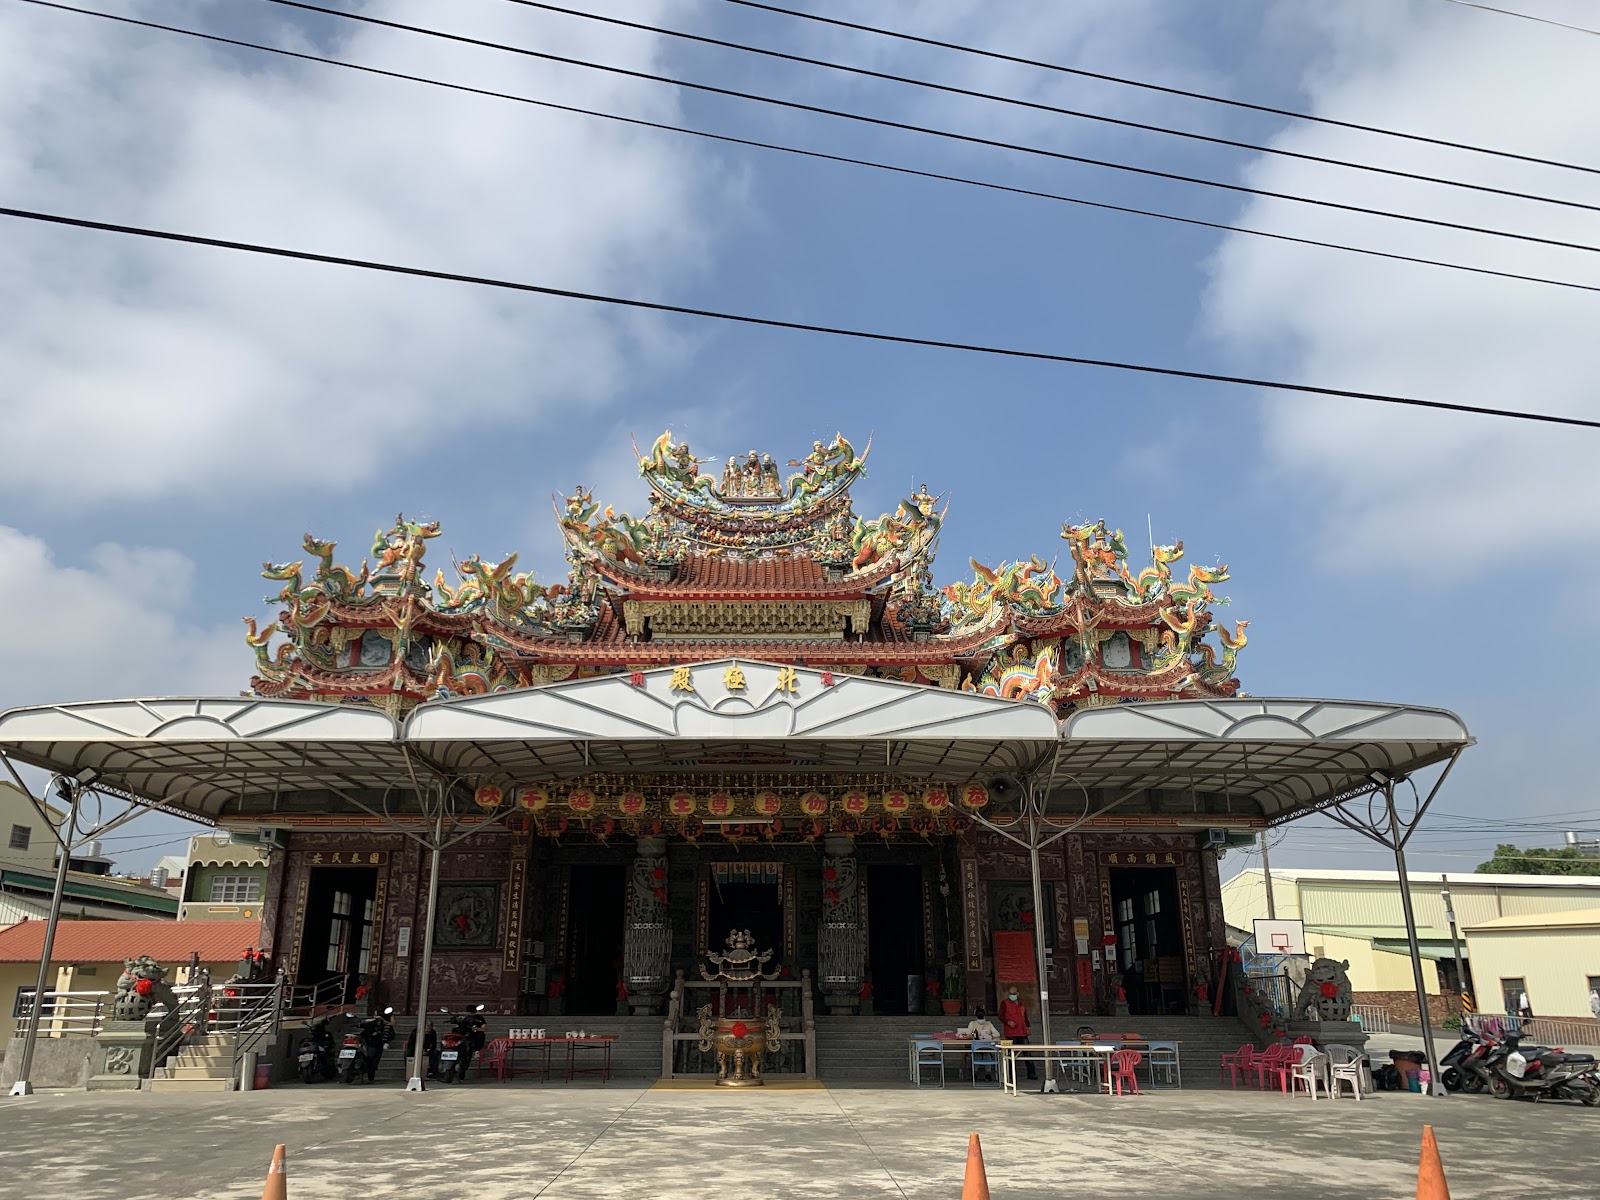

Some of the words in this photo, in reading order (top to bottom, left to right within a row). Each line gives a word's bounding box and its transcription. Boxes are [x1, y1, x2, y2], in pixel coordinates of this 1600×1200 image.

[669, 666, 798, 692] 北極殿
[312, 852, 380, 864] 國泰民安
[1108, 852, 1176, 865] 風調雨順
